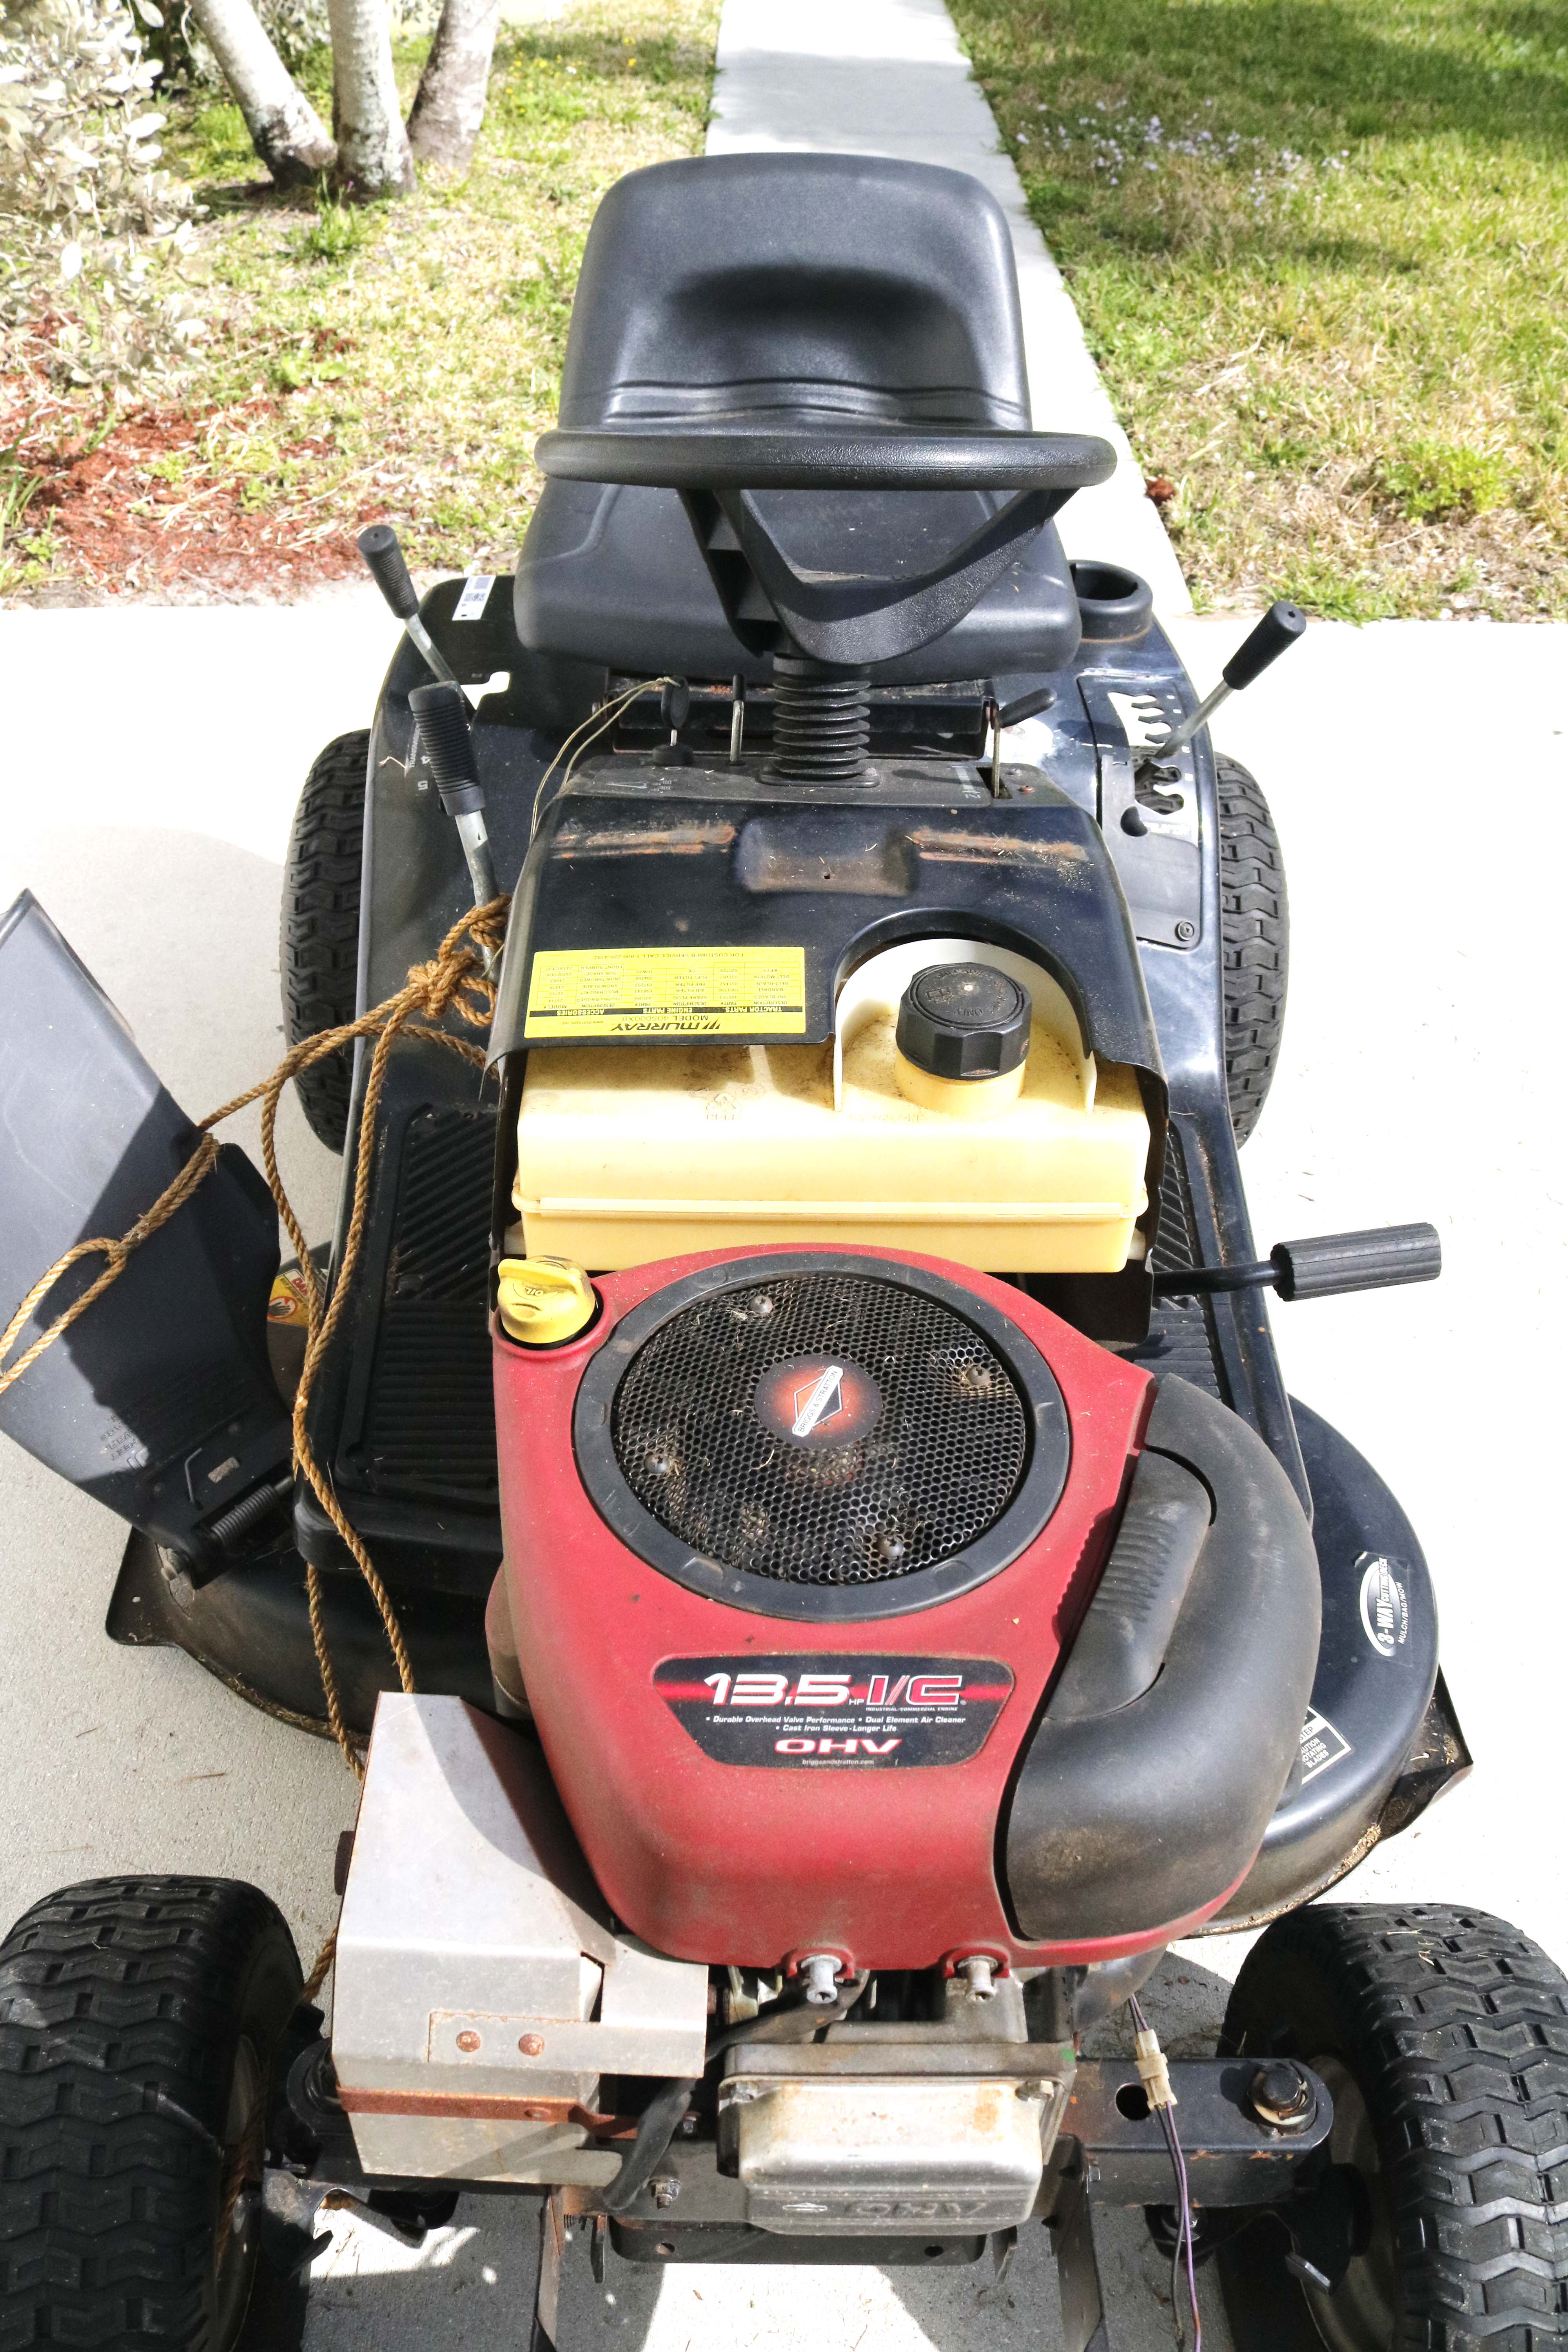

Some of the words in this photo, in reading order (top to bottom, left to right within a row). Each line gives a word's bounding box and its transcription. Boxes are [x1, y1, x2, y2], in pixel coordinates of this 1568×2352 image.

[610, 1022, 699, 1031] MURRAY
[526, 1287, 544, 1296] OIL
[797, 1408, 816, 1432] BRIGGS
[816, 1370, 838, 1402] STRATTON
[1378, 1557, 1389, 1575] DECK
[1379, 1573, 1390, 1602] CUTTING
[1376, 1597, 1395, 1644] 3-WAY
[1395, 1581, 1409, 1645] MULCH/BAG/MOW
[704, 1673, 852, 1706] 13.5
[774, 1738, 903, 1754] OHV
[1301, 1737, 1320, 1754] AUTION
[1306, 1749, 1329, 1768] BLADES
